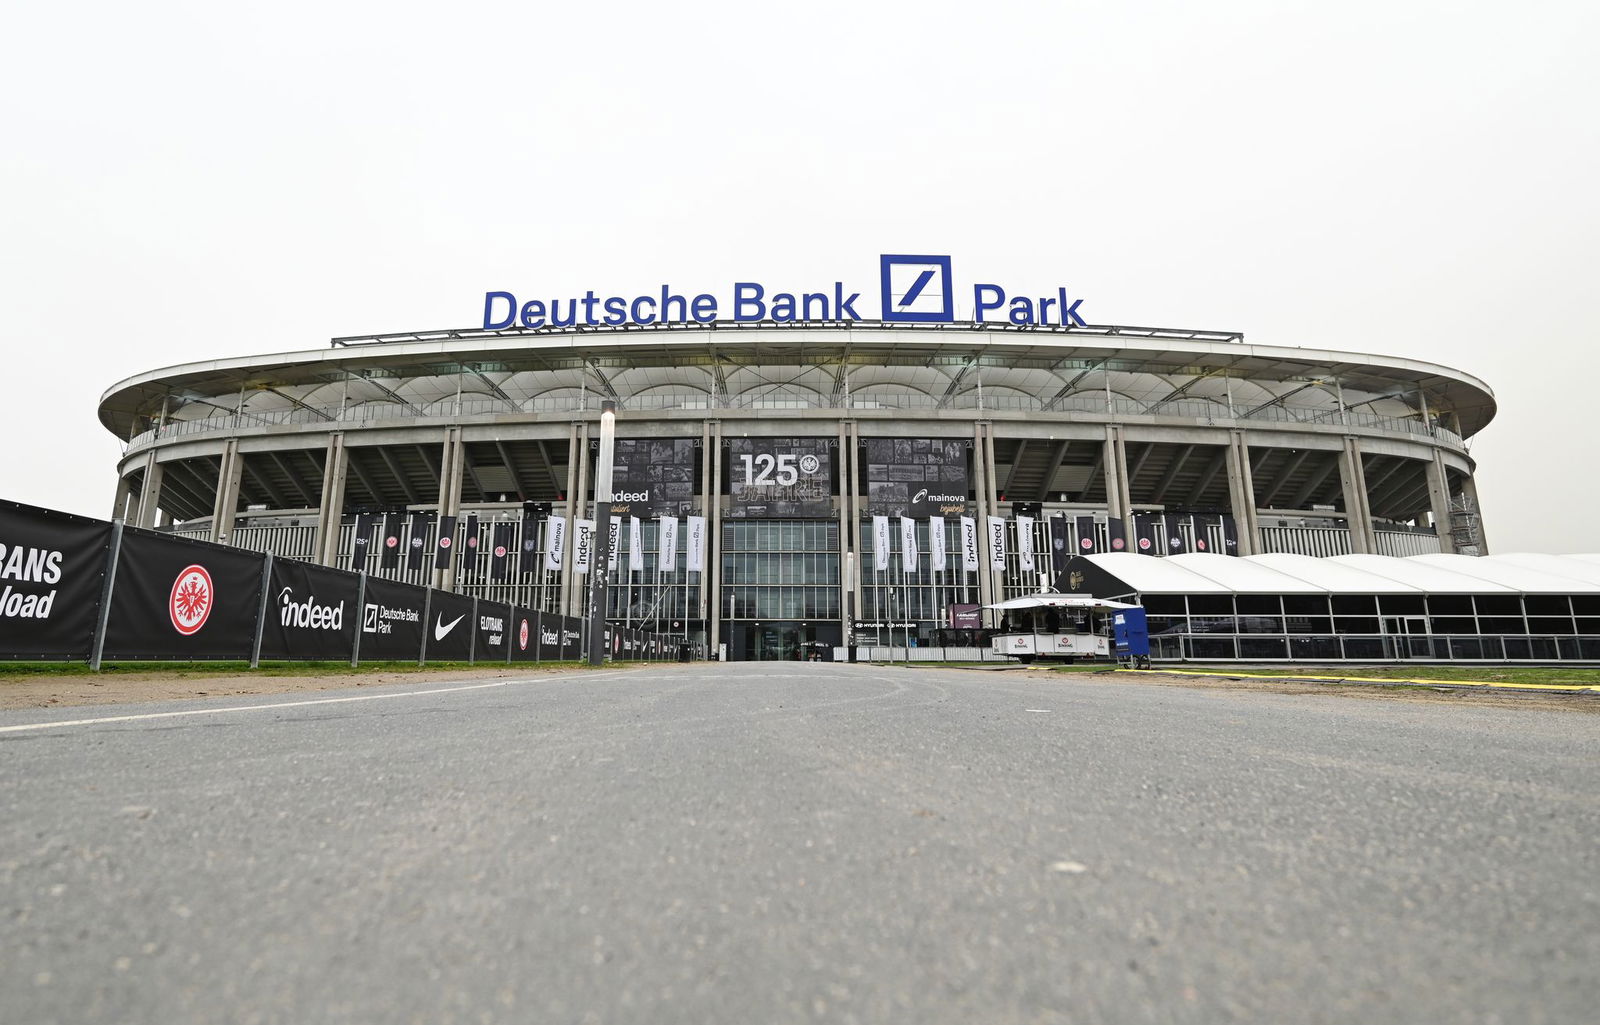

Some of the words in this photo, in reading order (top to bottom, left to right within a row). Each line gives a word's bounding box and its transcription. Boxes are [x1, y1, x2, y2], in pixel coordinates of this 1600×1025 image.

[484, 284, 718, 330] Deutsche
[734, 281, 861, 323] Bank
[974, 283, 1085, 328] Park
[740, 454, 799, 486] 125
[611, 489, 649, 502] ndeed
[737, 478, 824, 502] JAHRE
[928, 493, 965, 502] mainova
[993, 523, 1003, 562] indeed
[278, 587, 344, 630] indeed
[379, 605, 406, 621] Deutsche
[406, 608, 419, 622] Bank
[377, 621, 392, 634] Park
[541, 625, 559, 645] indeed
